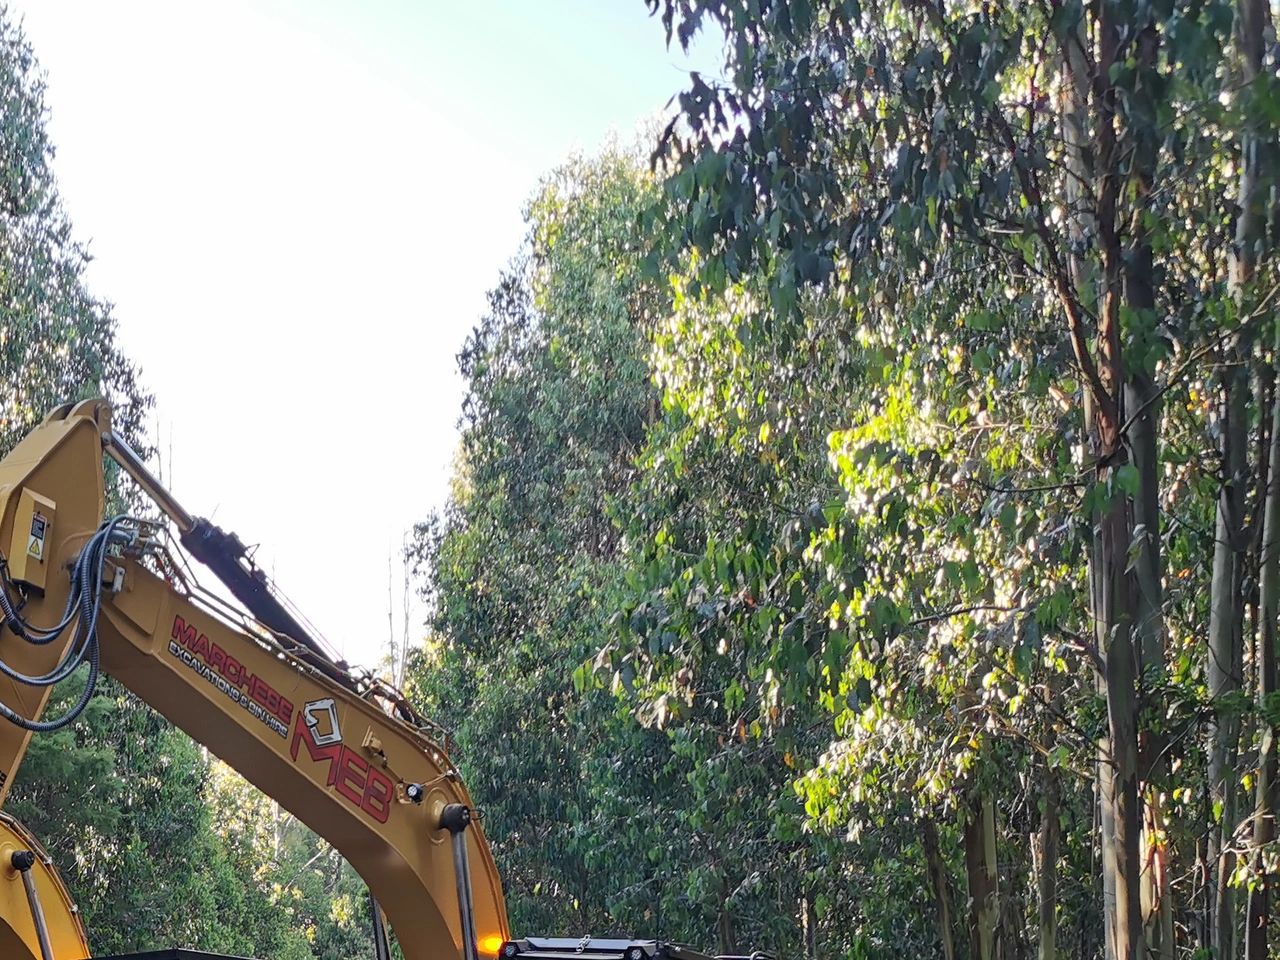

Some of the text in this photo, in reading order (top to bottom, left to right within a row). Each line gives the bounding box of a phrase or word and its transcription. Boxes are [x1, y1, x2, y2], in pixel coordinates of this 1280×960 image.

[168, 639, 289, 739] EXCAVATIONS & BIN HIRE
[172, 614, 293, 725] MARCHESE
[290, 710, 393, 824] MEB
